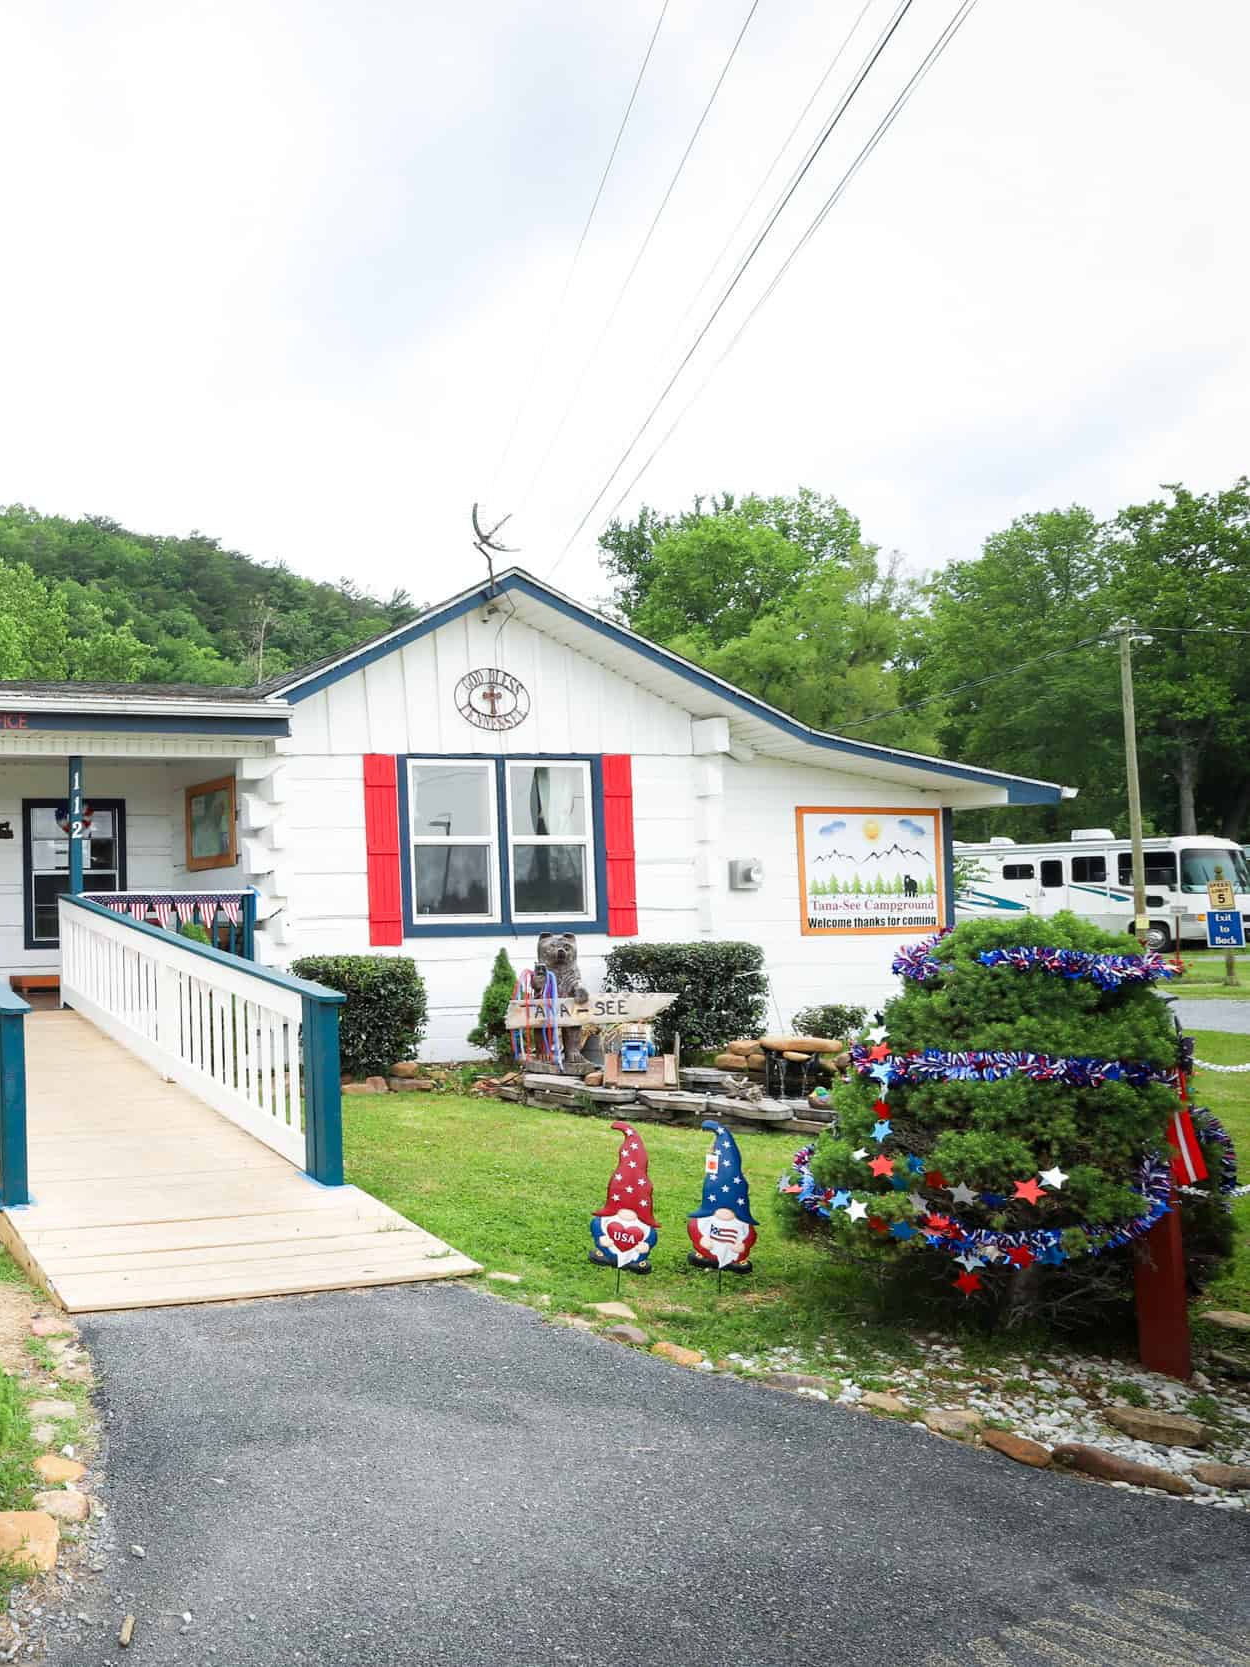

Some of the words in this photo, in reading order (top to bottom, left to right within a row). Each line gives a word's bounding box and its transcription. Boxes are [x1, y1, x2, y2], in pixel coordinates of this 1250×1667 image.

[461, 671, 484, 690] GOD
[487, 669, 524, 695] BLESS
[458, 704, 529, 731] TENNESSEE
[1217, 893, 1226, 904] 5
[813, 899, 861, 911] Tana-See
[864, 899, 934, 912] Campground
[807, 917, 852, 929] Welcome
[854, 916, 886, 928] thanks
[887, 915, 901, 927] for
[902, 914, 937, 927] coming
[1215, 913, 1231, 921] Exit
[1220, 925, 1230, 933] to
[1215, 936, 1237, 945] Back
[613, 1231, 636, 1245] USA
